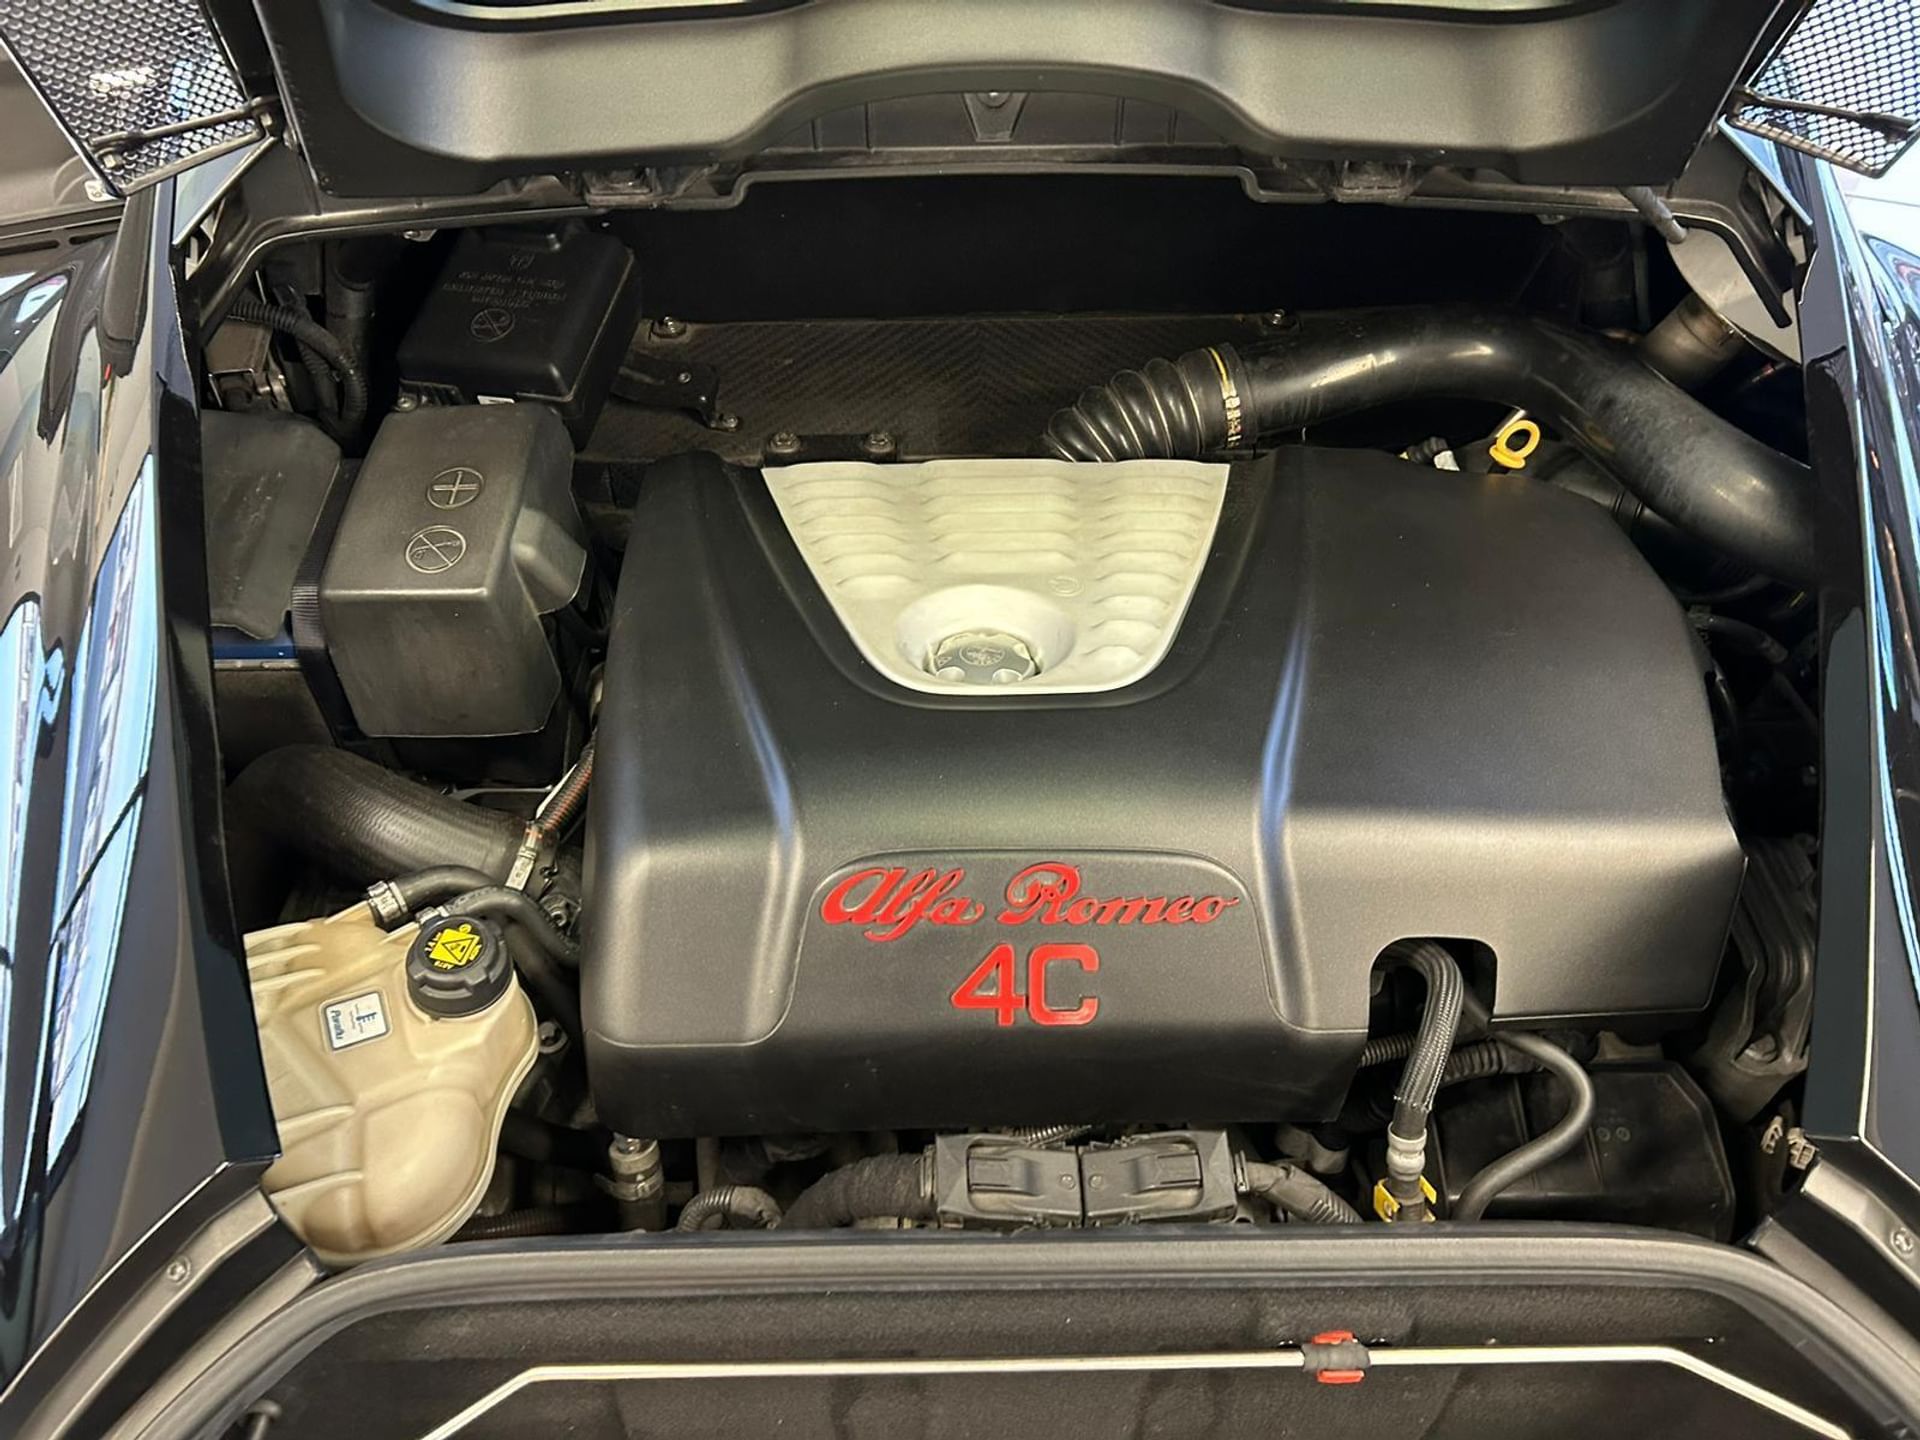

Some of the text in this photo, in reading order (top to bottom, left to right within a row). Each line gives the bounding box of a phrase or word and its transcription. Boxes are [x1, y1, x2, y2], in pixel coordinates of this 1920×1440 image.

[821, 860, 1239, 942] Alfa Romeo
[951, 943, 1099, 1027] 4C
